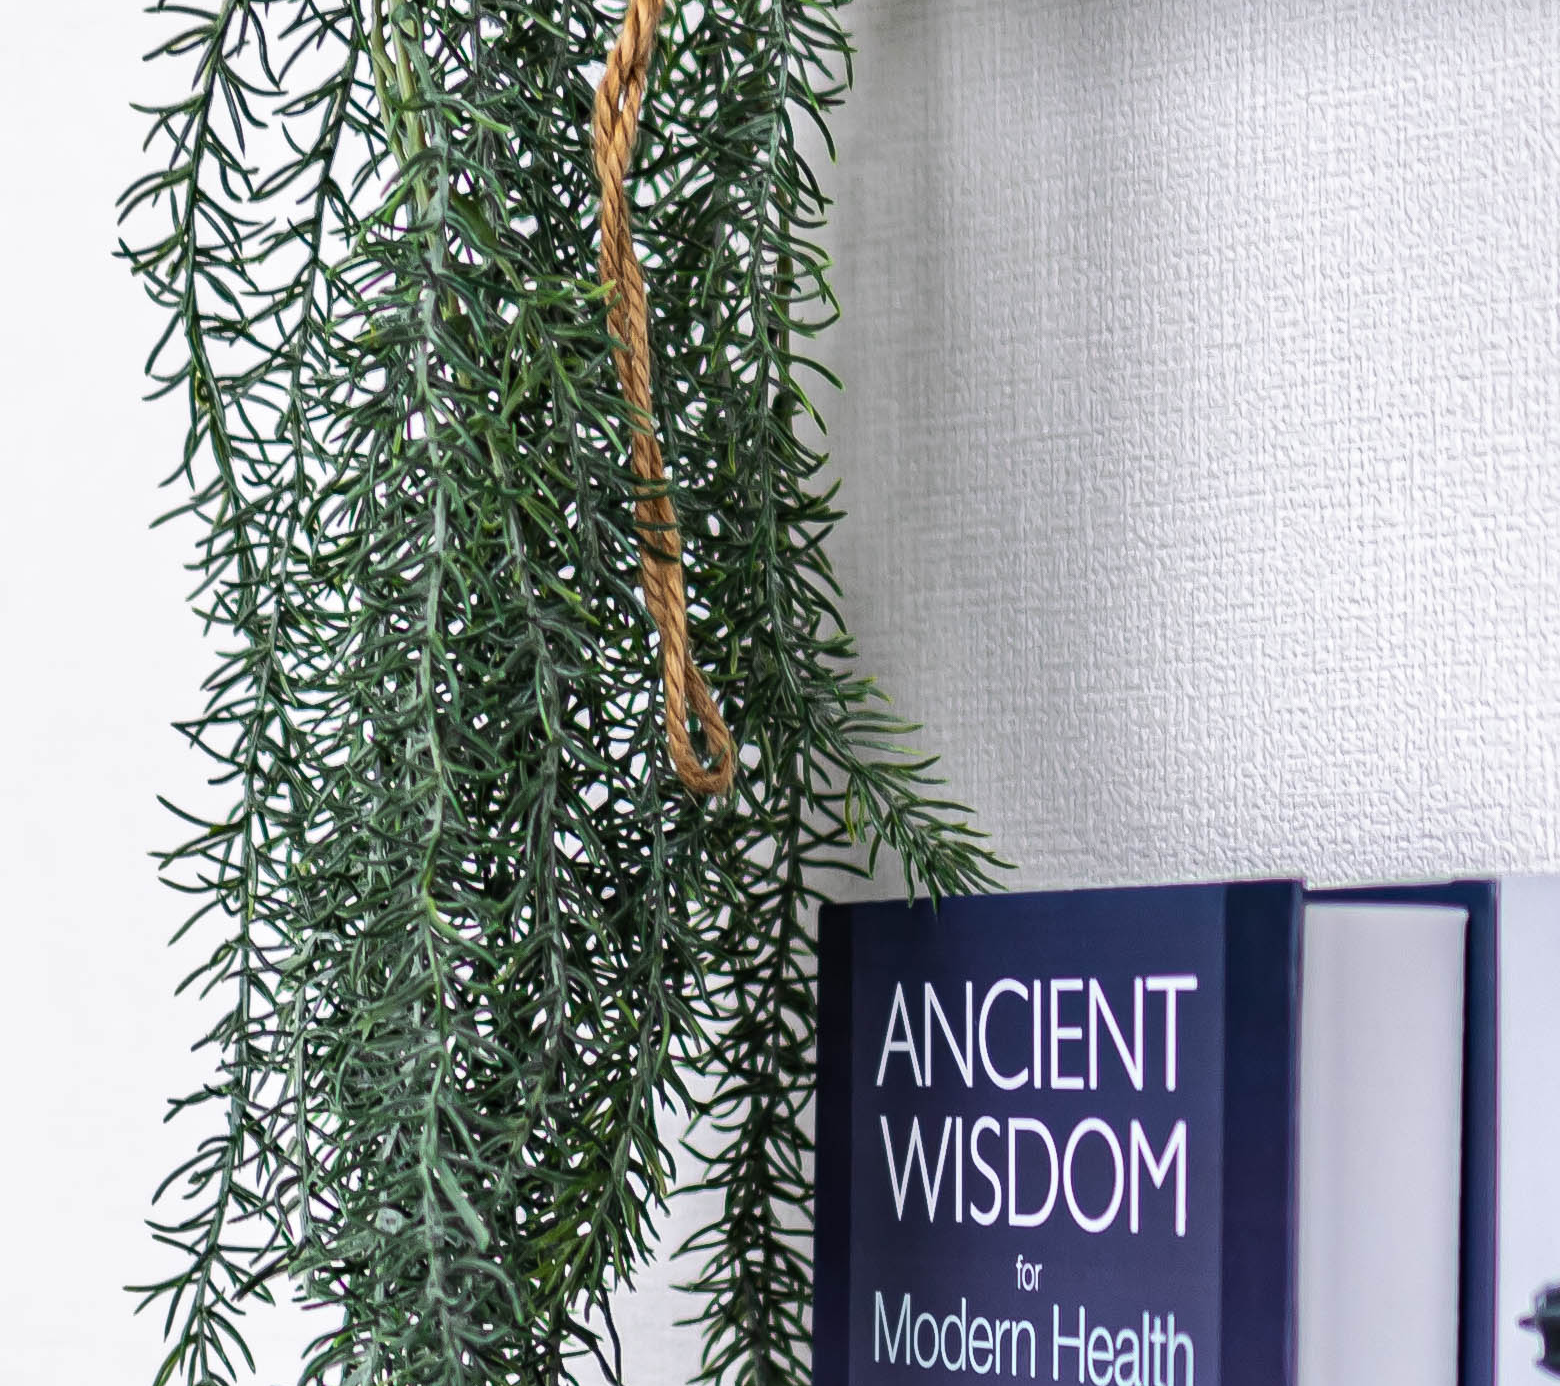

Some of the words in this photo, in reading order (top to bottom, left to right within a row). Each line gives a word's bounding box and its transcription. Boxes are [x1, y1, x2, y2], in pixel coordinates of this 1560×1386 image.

[876, 975, 1198, 1092] ANCIENT
[880, 1115, 1187, 1237] WISDOM
[1016, 1254, 1043, 1292] for
[874, 1291, 1036, 1378] Modern
